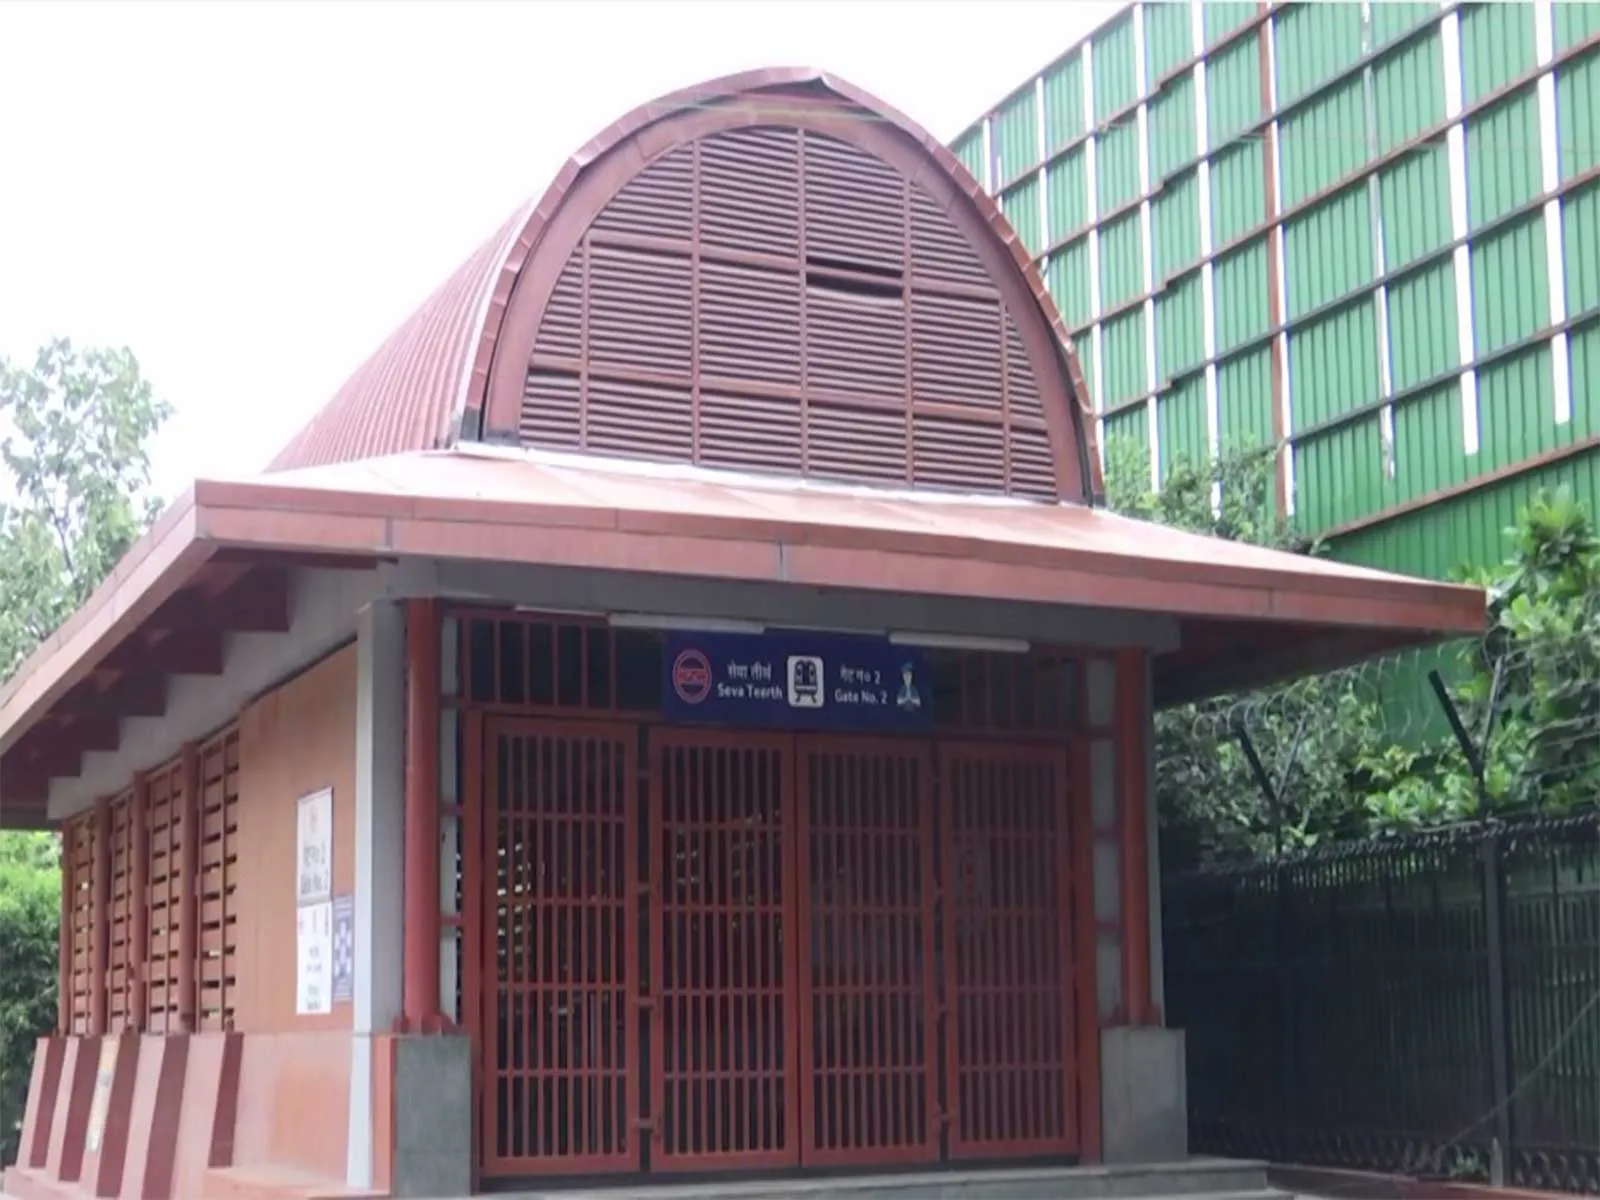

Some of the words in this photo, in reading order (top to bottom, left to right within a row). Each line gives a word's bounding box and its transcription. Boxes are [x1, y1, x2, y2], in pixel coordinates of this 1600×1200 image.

[874, 670, 881, 685] 2
[717, 682, 744, 698] Seva
[746, 683, 783, 699] Teerth
[834, 688, 859, 704] Gate
[861, 689, 878, 704] No.
[881, 690, 888, 704] 2
